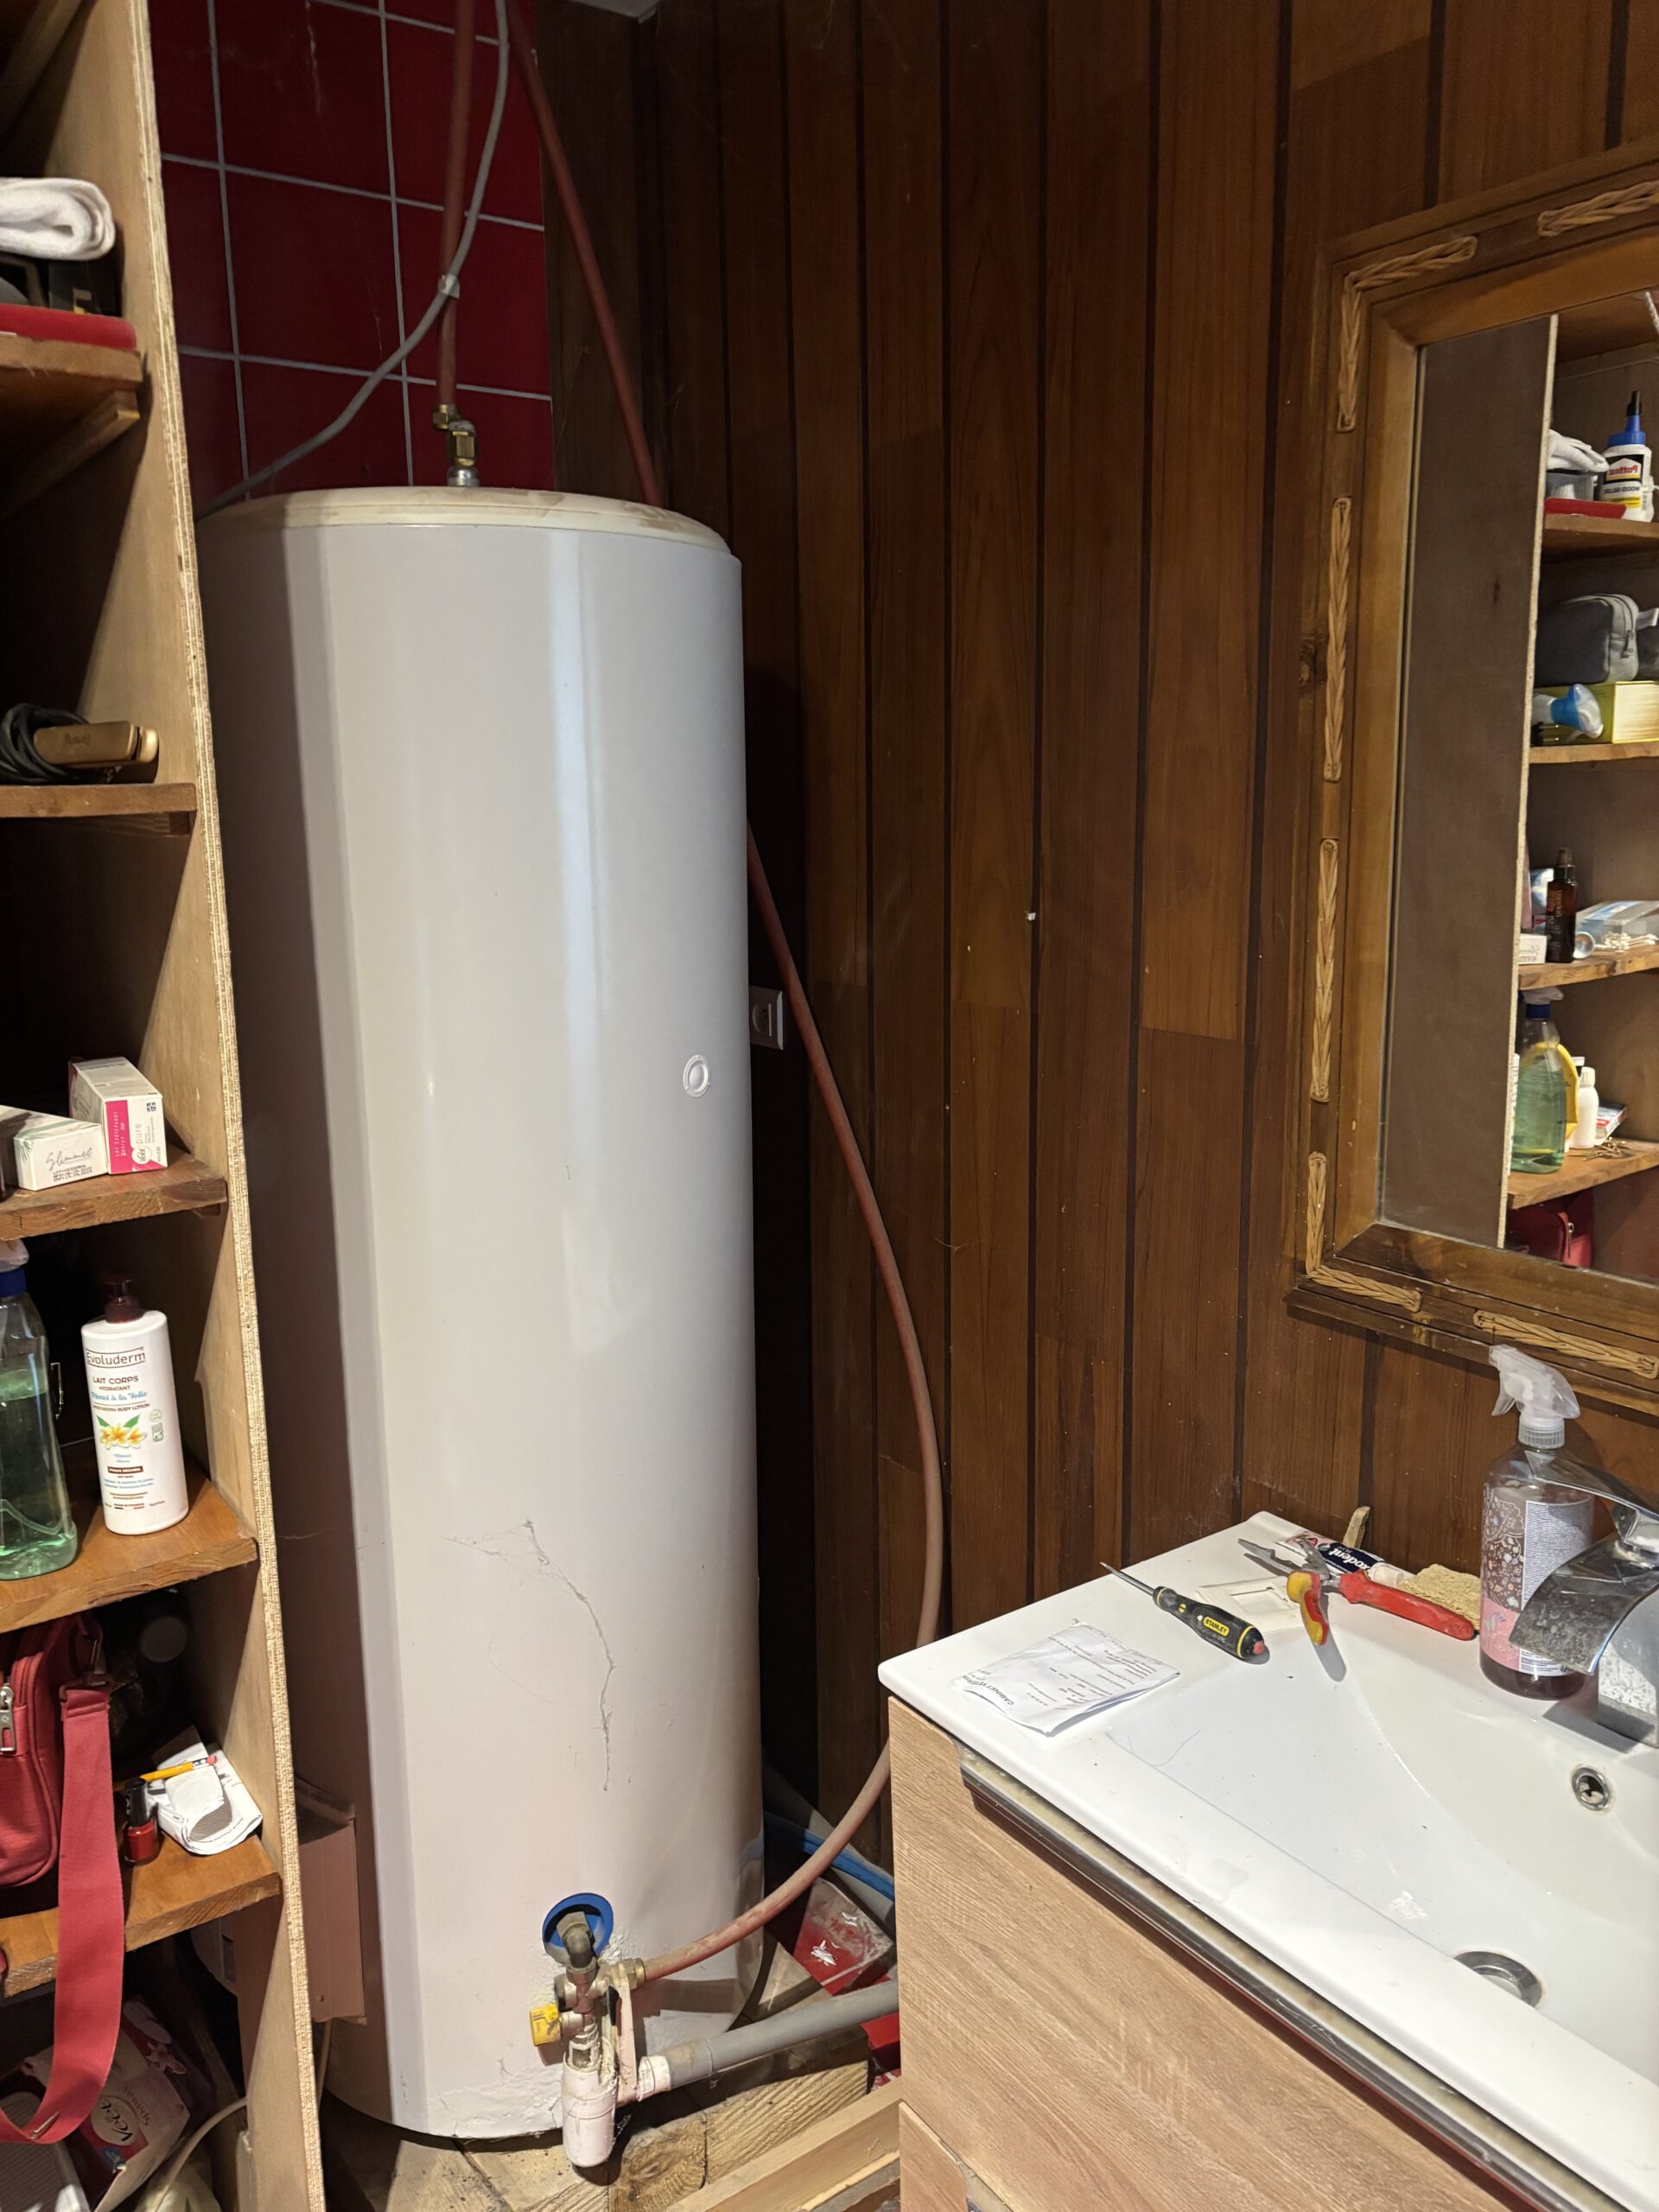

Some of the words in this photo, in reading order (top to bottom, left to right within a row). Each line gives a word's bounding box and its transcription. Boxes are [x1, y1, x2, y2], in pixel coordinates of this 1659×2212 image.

[135, 1123, 143, 1144] pure
[86, 1352, 146, 1365] Evoluderm
[109, 1376, 139, 1385] CORPS
[1205, 1618, 1228, 1634] STANLEY
[985, 1685, 1014, 1706] CABINET
[101, 2101, 133, 2141] Veet
